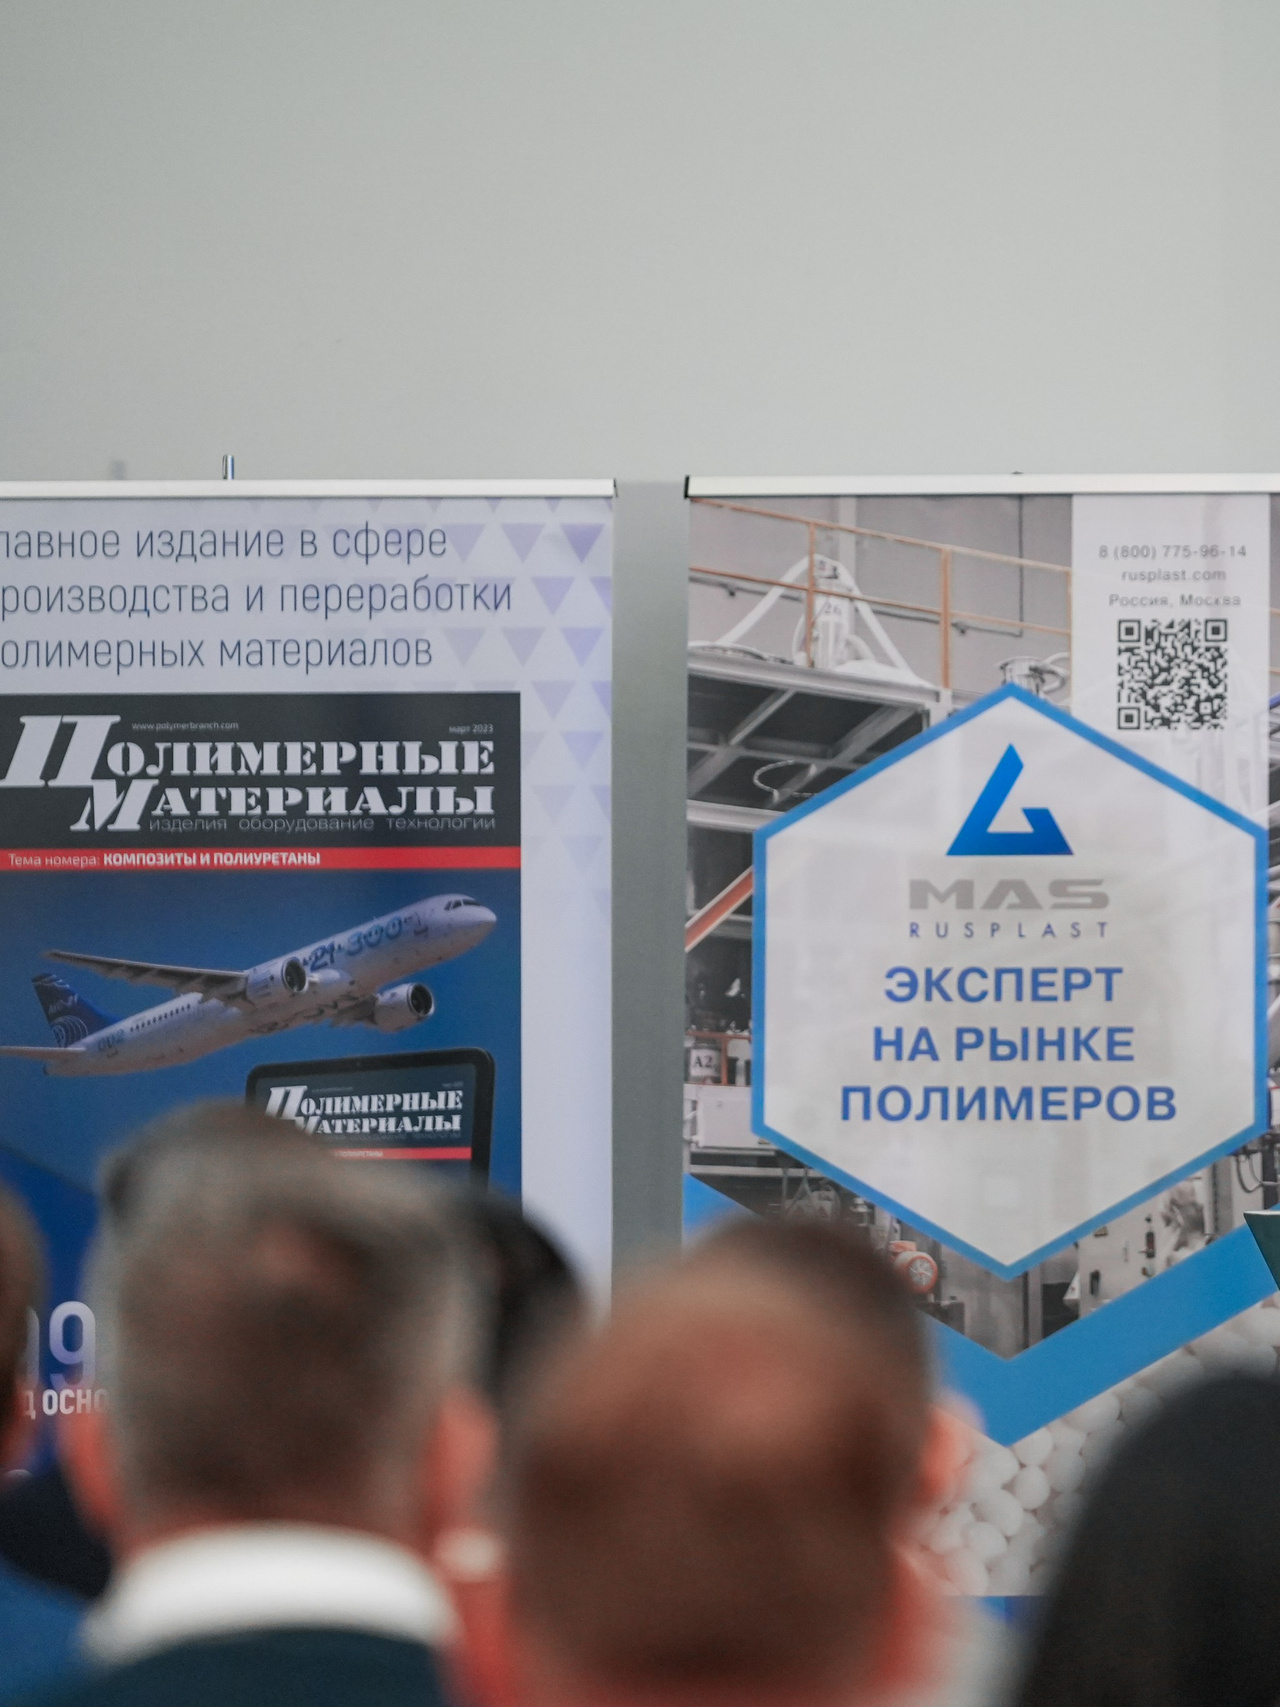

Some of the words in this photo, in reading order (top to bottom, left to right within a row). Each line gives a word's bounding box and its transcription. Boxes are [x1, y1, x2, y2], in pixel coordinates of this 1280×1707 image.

[136, 529, 284, 563] издание
[300, 529, 318, 557] в
[332, 520, 447, 565] сфере
[1098, 544, 1109, 558] 8
[1113, 544, 1157, 560] (800)
[1162, 544, 1247, 558] 775-96-14
[1121, 568, 1227, 583] rusplast.com
[0, 584, 229, 621] роизводства
[246, 584, 263, 612] и
[280, 574, 512, 620] переработки
[1179, 593, 1242, 607] Москва
[0, 638, 204, 676] олимерных
[219, 637, 433, 675] материалов
[131, 721, 239, 732] www.polymerbranch.com
[472, 723, 494, 734] 2023
[149, 817, 228, 833] изделия
[238, 815, 375, 834] оборудование
[386, 816, 496, 831] технологии
[8, 852, 42, 867] Тема
[103, 851, 197, 867] КОМПОЗИТЫ
[200, 852, 211, 866] И
[213, 851, 321, 866] ПОЛИУРЕТАНЫ
[908, 878, 1111, 911] MAS
[908, 921, 1109, 939] RUSPLAST
[884, 965, 1124, 1004] ЭКСПЕРТ
[873, 1026, 941, 1062] НА
[954, 1026, 1136, 1062] РЫНКЕ
[841, 1084, 1178, 1122] ПОЛИМЕРОВ
